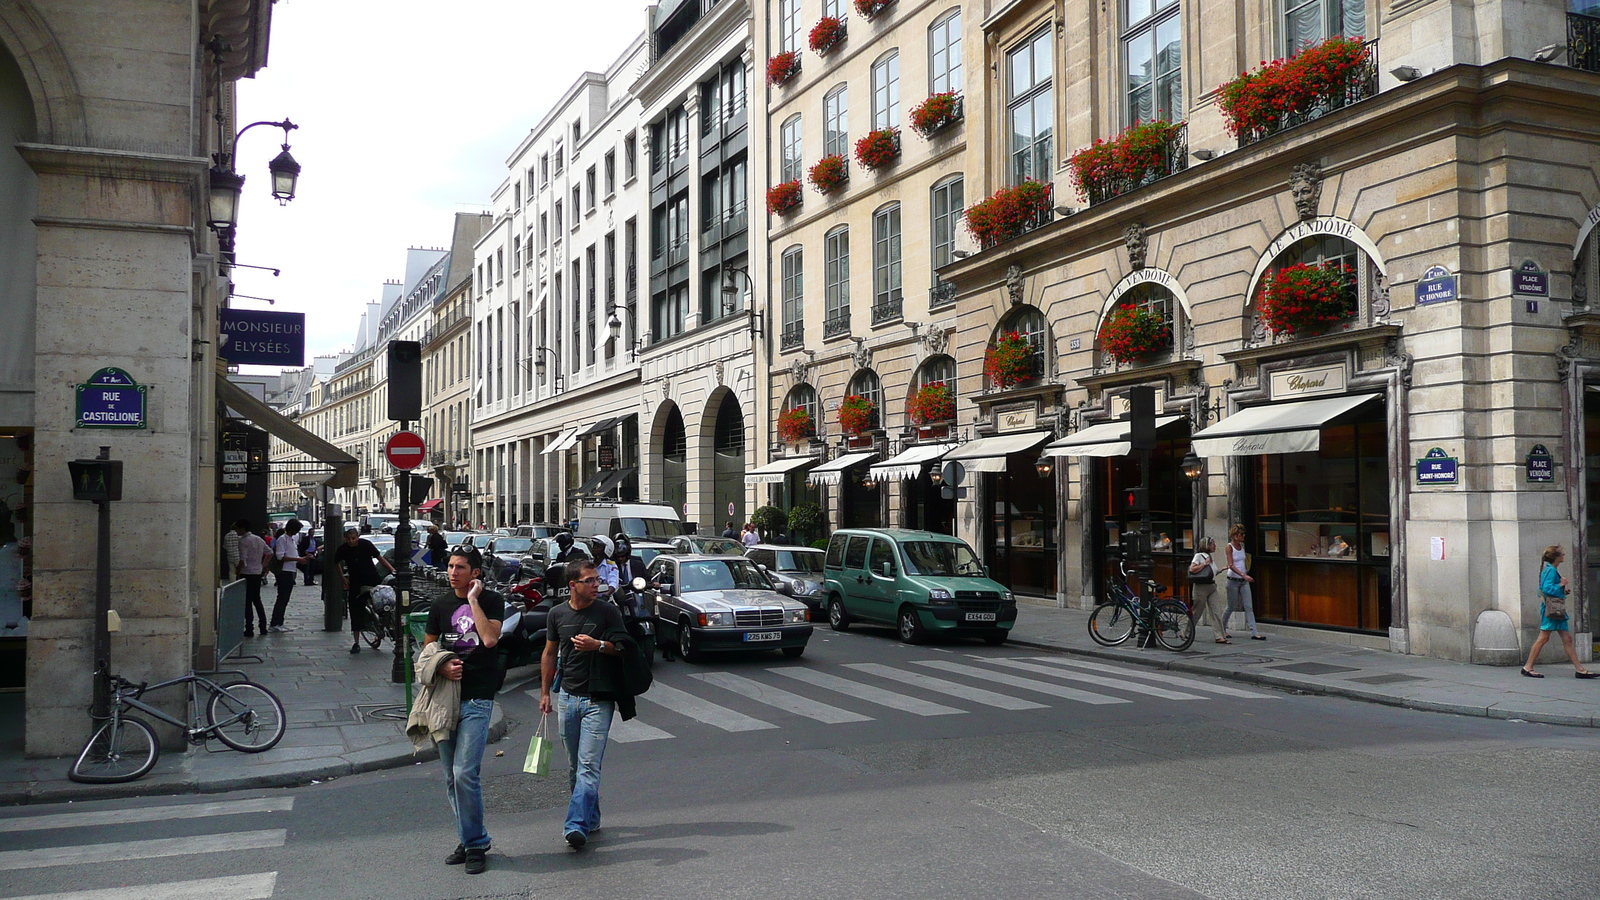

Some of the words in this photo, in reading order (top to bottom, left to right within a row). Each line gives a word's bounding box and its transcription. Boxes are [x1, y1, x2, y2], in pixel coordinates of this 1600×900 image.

[1268, 240, 1284, 258] LE
[1289, 218, 1355, 239] VENDÔME
[1112, 285, 1123, 300] LE
[1428, 283, 1442, 292] RUE
[1519, 284, 1542, 292] VENDÔME
[1426, 288, 1452, 301] HONORÉ
[1531, 302, 1534, 311] 1
[223, 321, 302, 334] MONSIEUR
[235, 339, 290, 354] ELYSÉES
[1286, 372, 1328, 392] Chopard
[102, 391, 120, 401] RUE
[83, 412, 140, 422] CASTIGLIONE
[1005, 414, 1027, 428] Chopard
[1232, 437, 1269, 454] Chopard
[1420, 471, 1455, 480] SAINT-HONORÉ
[1529, 469, 1551, 477] VENDÔME
